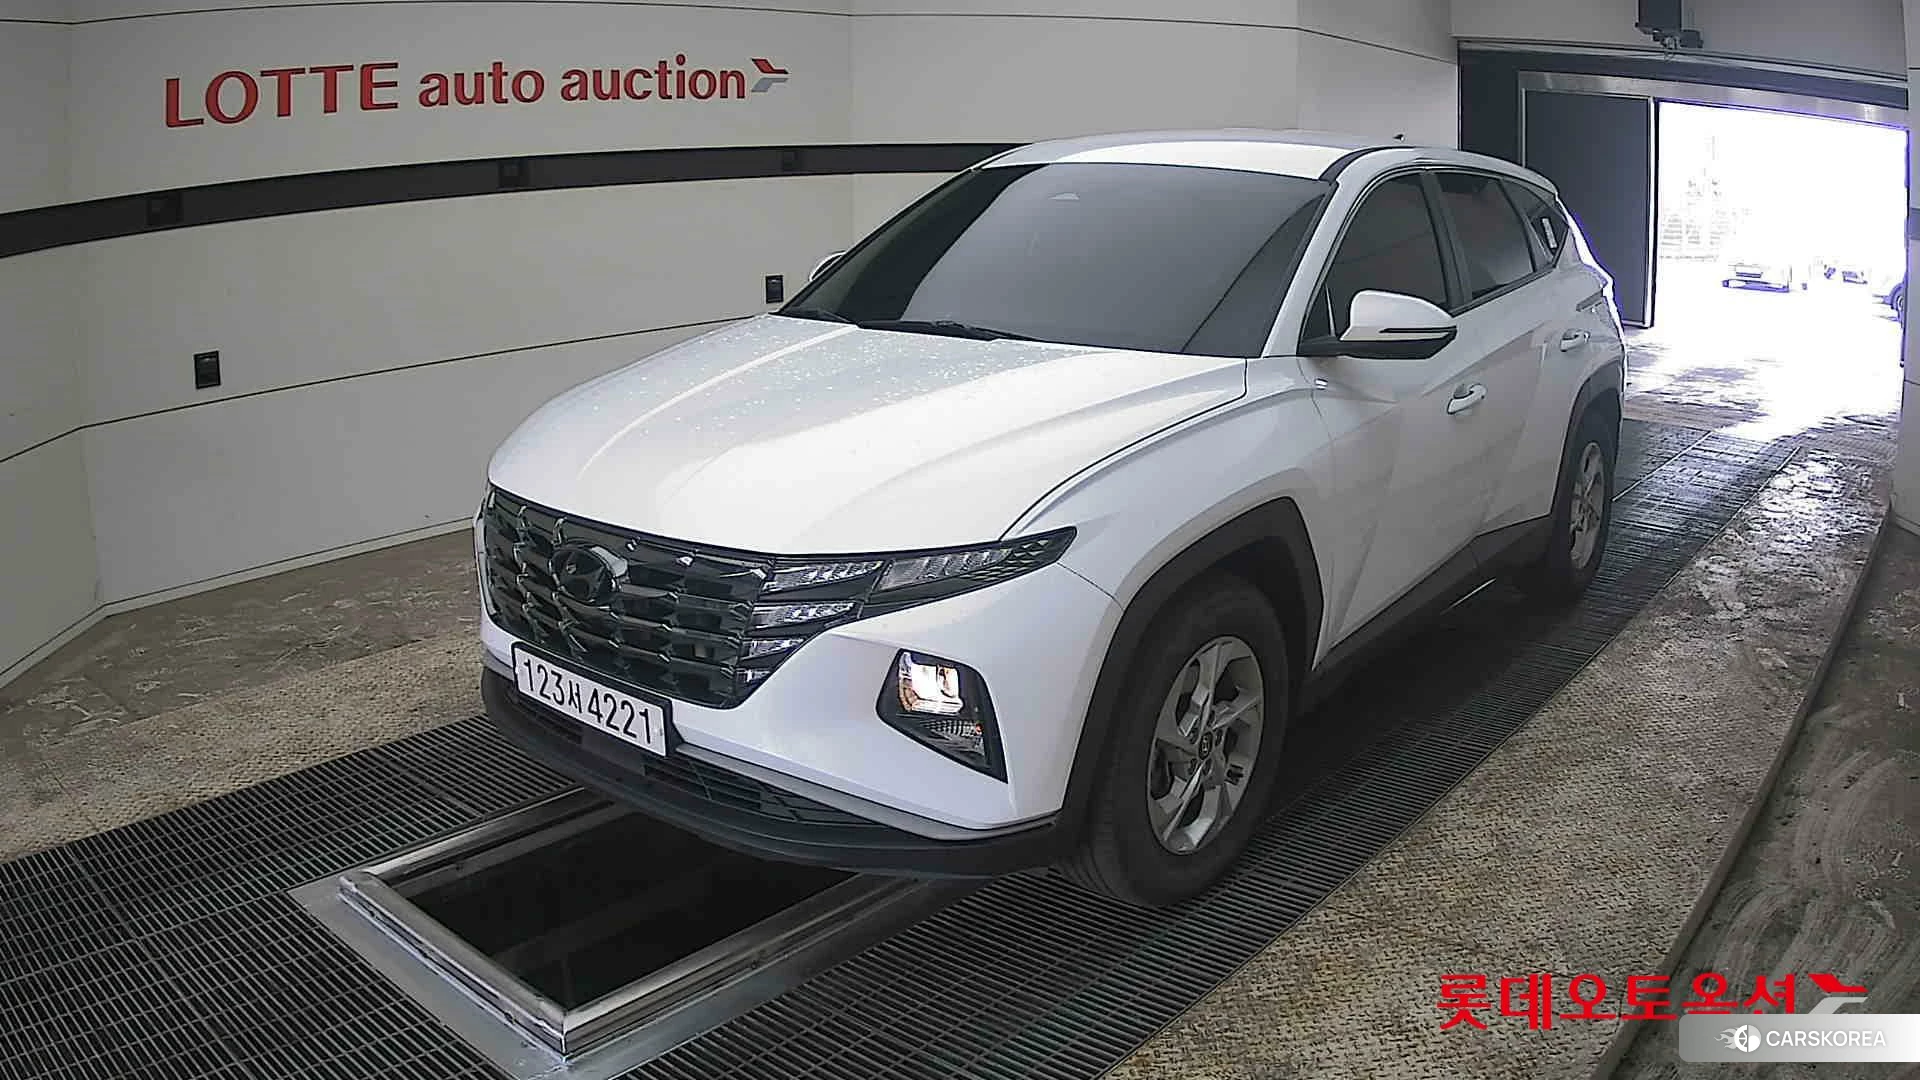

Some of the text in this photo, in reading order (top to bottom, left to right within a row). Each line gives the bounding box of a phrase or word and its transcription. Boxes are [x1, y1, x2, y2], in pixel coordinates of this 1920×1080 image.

[165, 54, 747, 128] LOTTE auto auction
